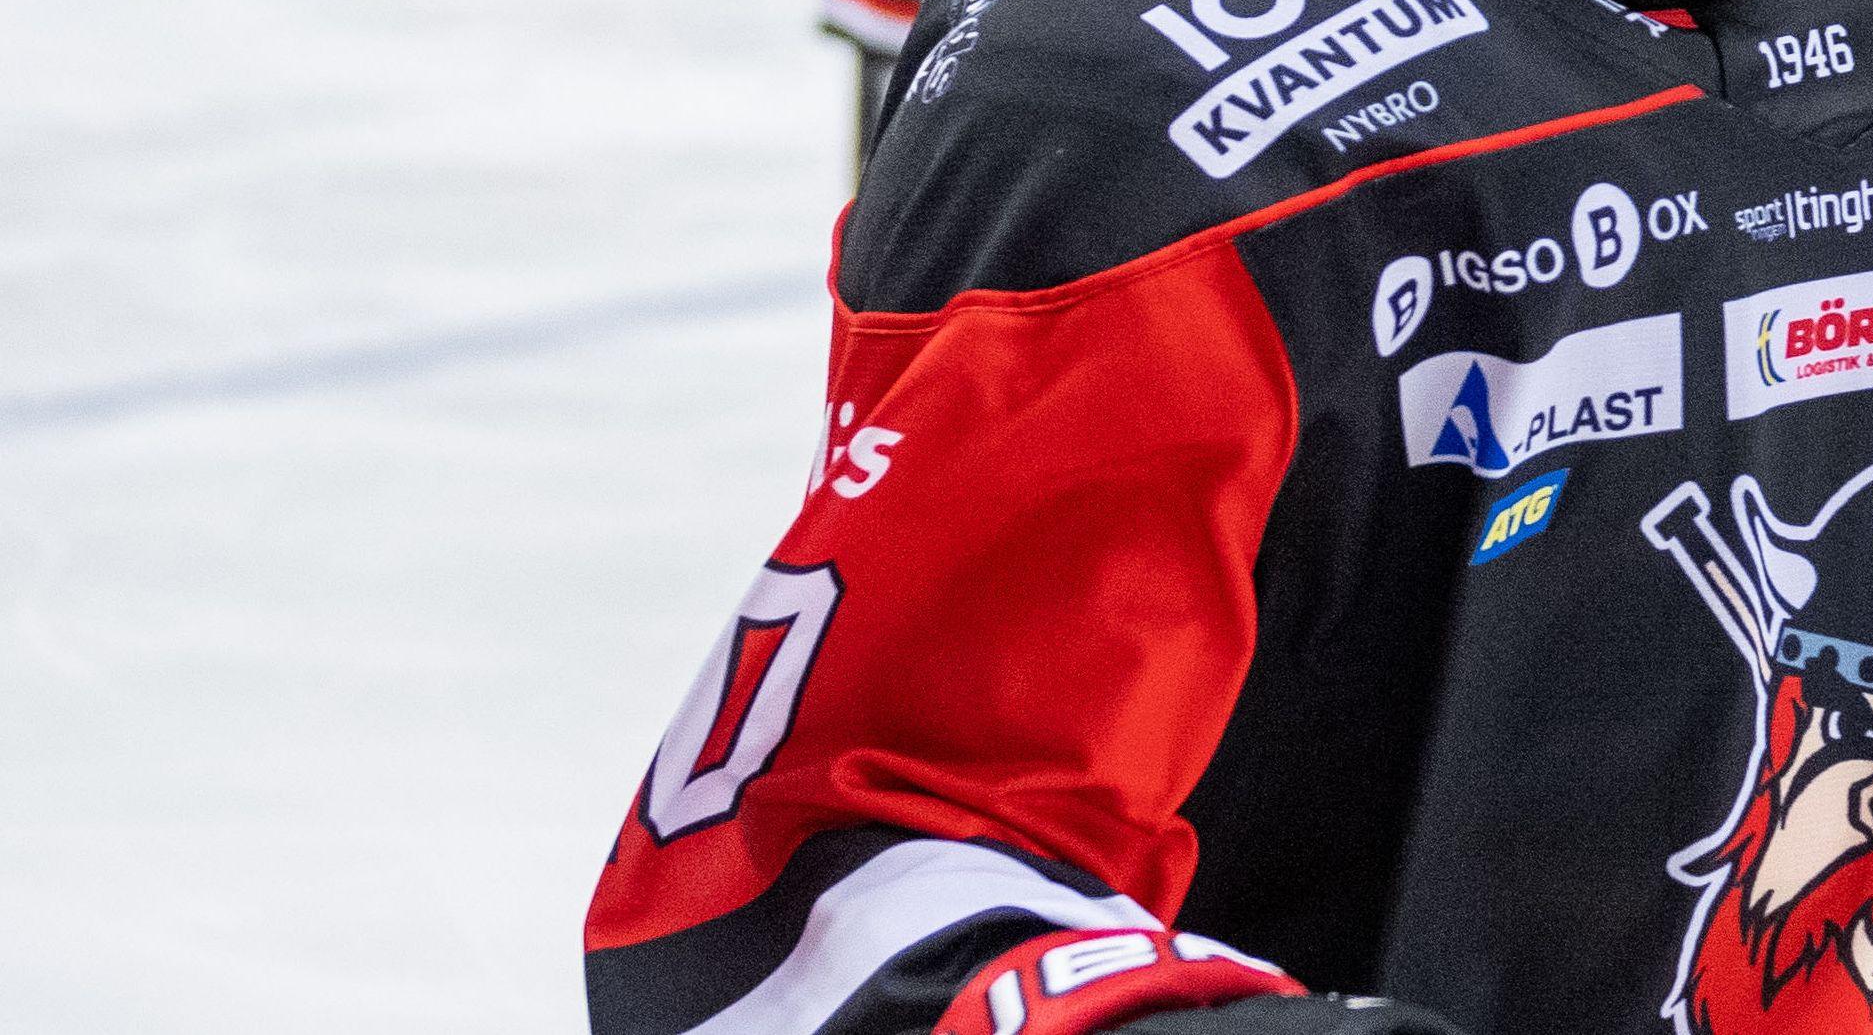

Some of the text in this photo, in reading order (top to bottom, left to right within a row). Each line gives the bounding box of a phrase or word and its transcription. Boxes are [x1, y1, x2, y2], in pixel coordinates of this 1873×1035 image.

[1758, 23, 1856, 89] 1946
[1321, 79, 1440, 154] NYBRO
[1796, 355, 1862, 380] LOGISTIK
[1479, 483, 1559, 552] ATG
